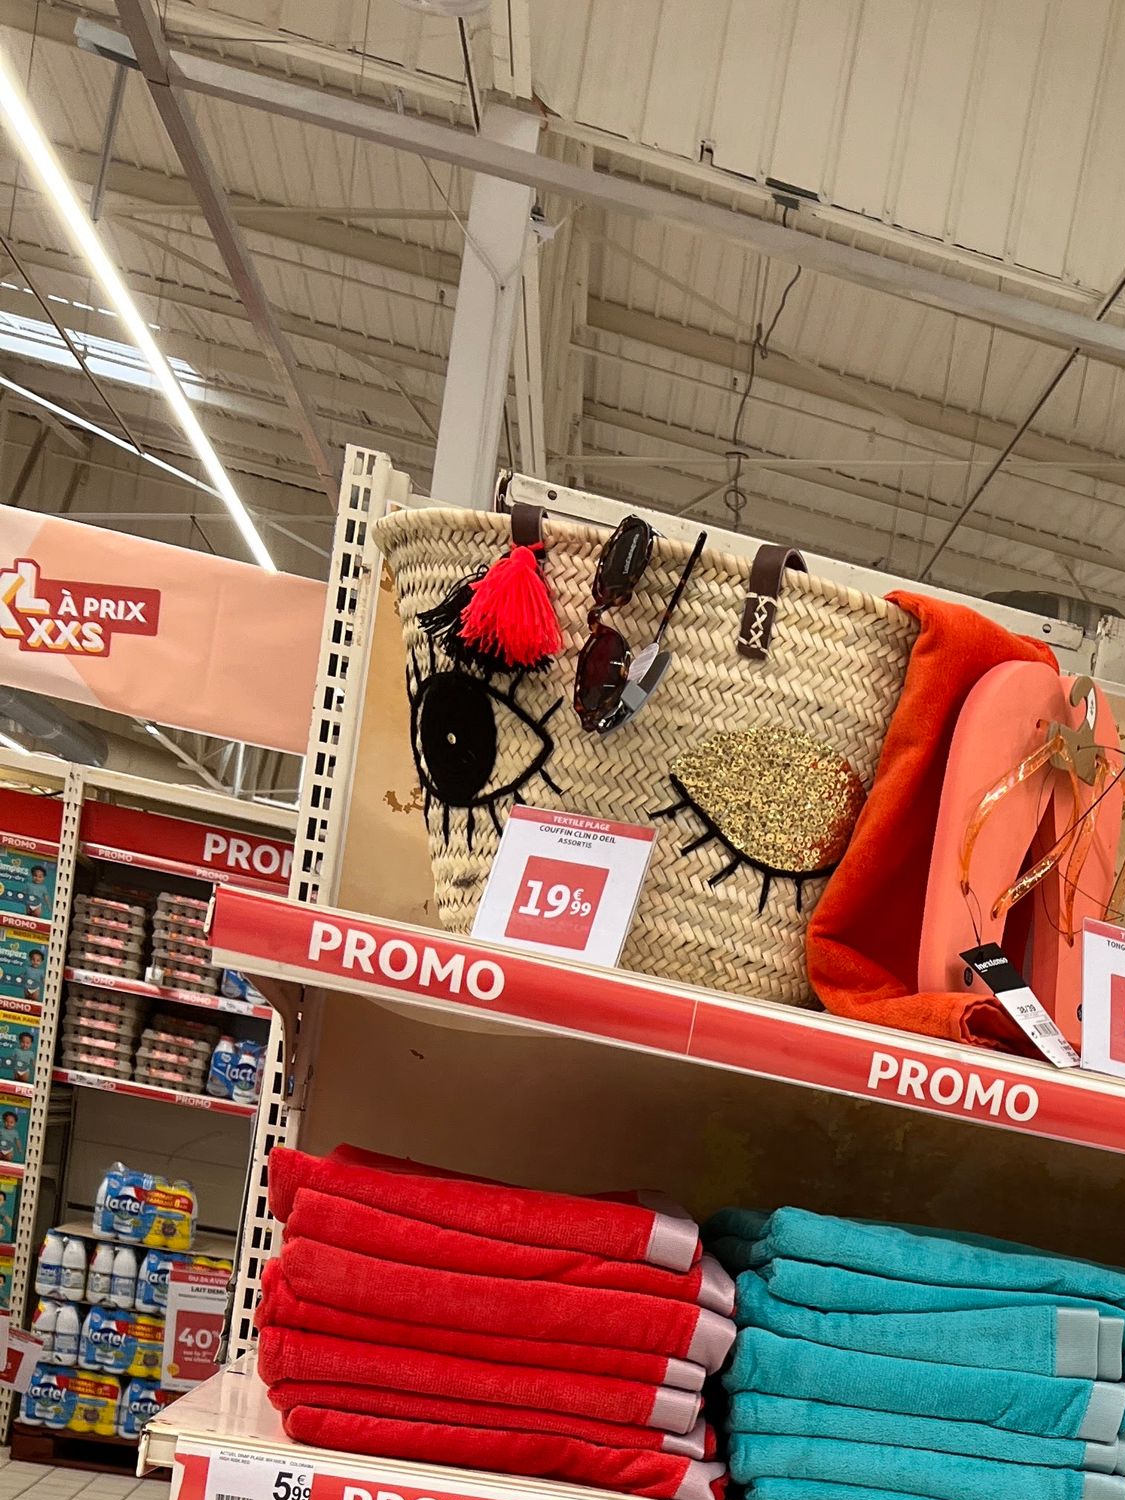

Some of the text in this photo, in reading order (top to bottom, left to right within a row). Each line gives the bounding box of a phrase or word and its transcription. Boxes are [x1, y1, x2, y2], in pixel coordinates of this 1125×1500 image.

[57, 588, 147, 624] À PRIX
[26, 617, 105, 652] XXS
[553, 815, 610, 831] TEXTILE PLAGE
[539, 824, 573, 837] COUFFIN
[573, 830, 592, 840] CLIN
[2, 835, 37, 850] PROMO
[557, 837, 592, 849] ASSORTIS
[98, 847, 133, 863] PROMO
[203, 832, 293, 879] PRO
[196, 867, 230, 882] PROMO
[2, 915, 37, 930] PROMO
[1106, 939, 1125, 951] TONG
[308, 920, 505, 1001] PROMO
[866, 1050, 1040, 1123] PROMO
[175, 1095, 211, 1109] PROMO
[106, 1195, 145, 1215] lactel
[88, 1327, 126, 1347] lactel
